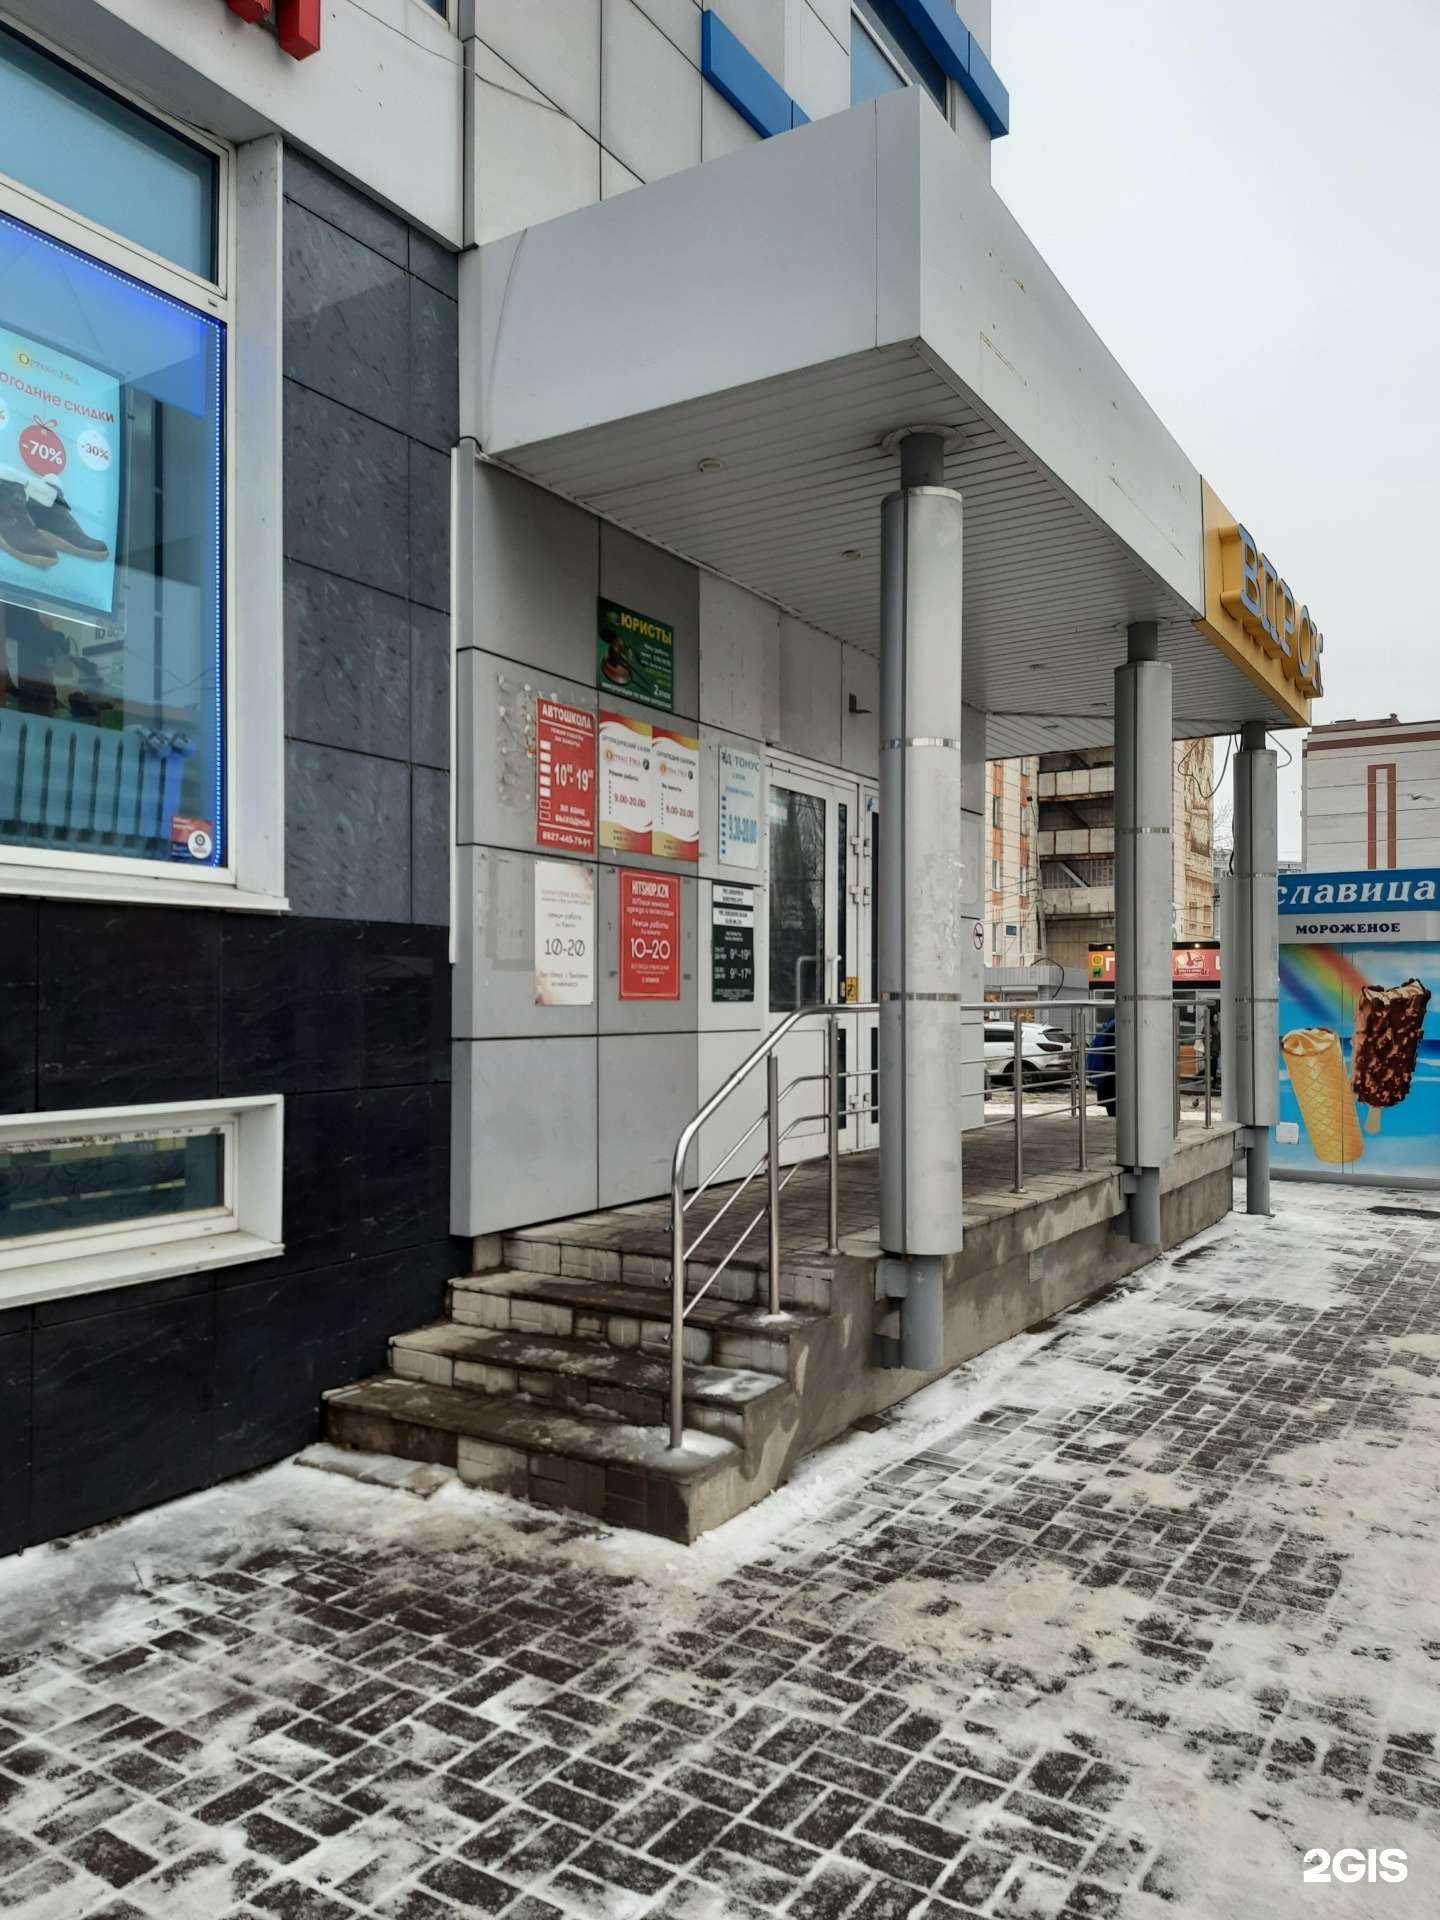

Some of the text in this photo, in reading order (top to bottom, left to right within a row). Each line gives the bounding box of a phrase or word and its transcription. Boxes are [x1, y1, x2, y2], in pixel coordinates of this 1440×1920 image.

[23, 440, 63, 465] -70%
[620, 612, 672, 646] ЮРИСТЫ
[542, 704, 592, 729] АВТОШКОЛА
[1296, 922, 1401, 935] МОРОЖЕНОЕ
[545, 938, 585, 957] 10-20
[630, 937, 670, 960] 10-20
